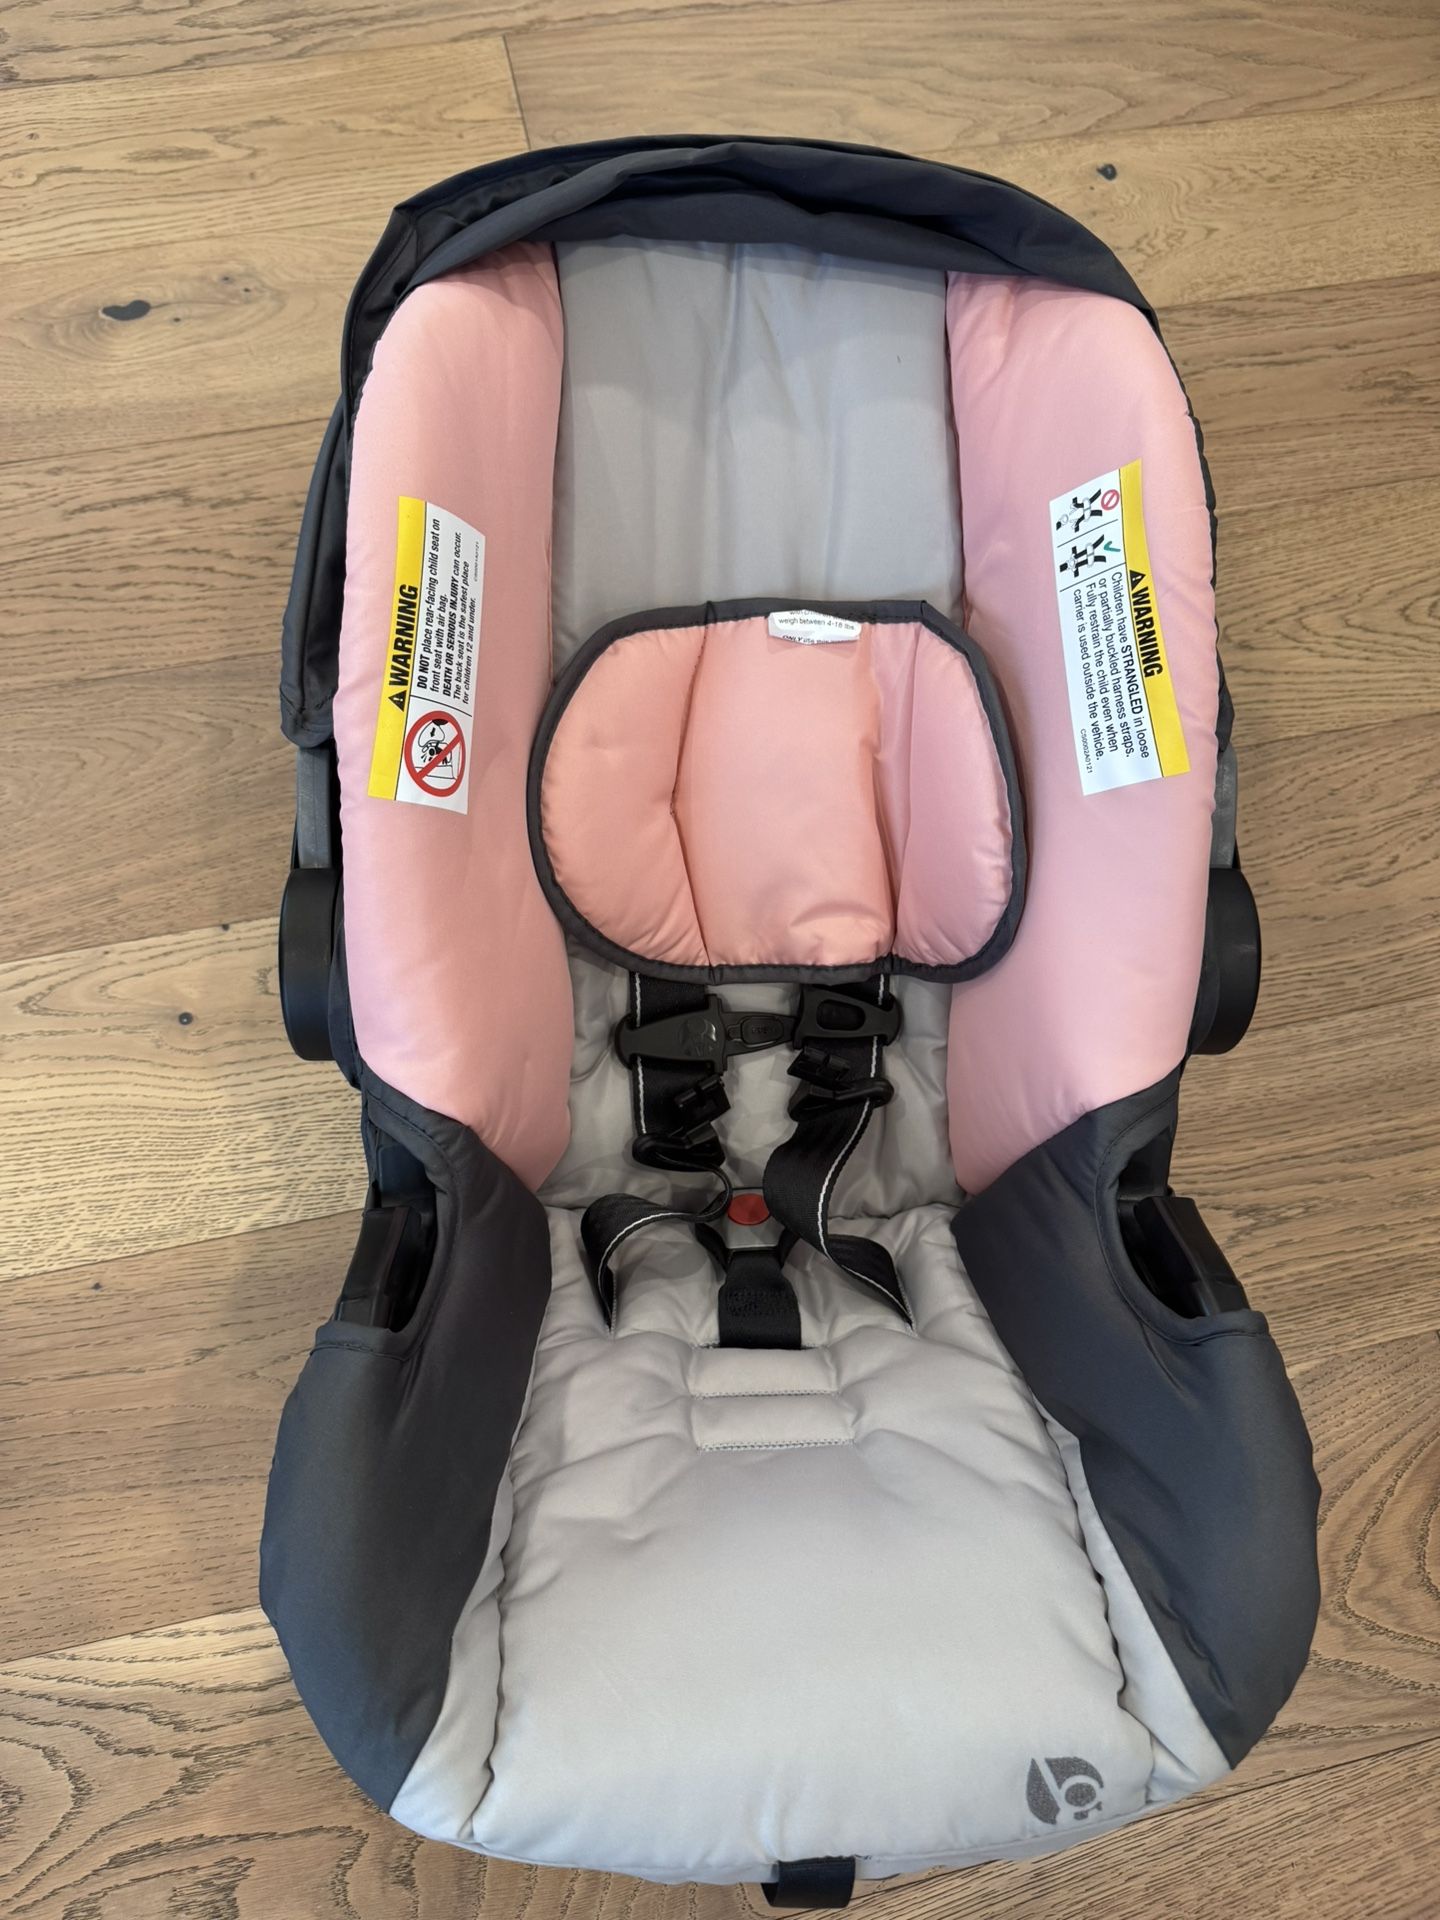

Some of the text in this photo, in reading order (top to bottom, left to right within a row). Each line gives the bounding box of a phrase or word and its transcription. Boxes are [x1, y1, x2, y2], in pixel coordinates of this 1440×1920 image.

[461, 561, 469, 586] place
[417, 519, 440, 689] DO NOT place rear-facing child seat on
[450, 576, 458, 610] INJURY
[459, 586, 468, 614] safest
[468, 598, 476, 624] under.
[389, 584, 418, 686] WARNING
[430, 594, 448, 692] front seat with air bag.
[446, 612, 456, 651] SERIOUS
[457, 631, 465, 639] is
[466, 642, 473, 653] 12
[1132, 586, 1163, 678] WARNING
[445, 652, 454, 666] OR
[455, 661, 463, 682] back
[463, 656, 471, 691] children
[1074, 589, 1105, 760] carrier is used outside the vehicle.
[1086, 583, 1119, 752] Fully restrain the child even when
[1098, 578, 1135, 757] or partially buckled harness straps.
[1112, 572, 1149, 758] Children have STRANGLED in loose
[443, 667, 453, 696] DEATH
